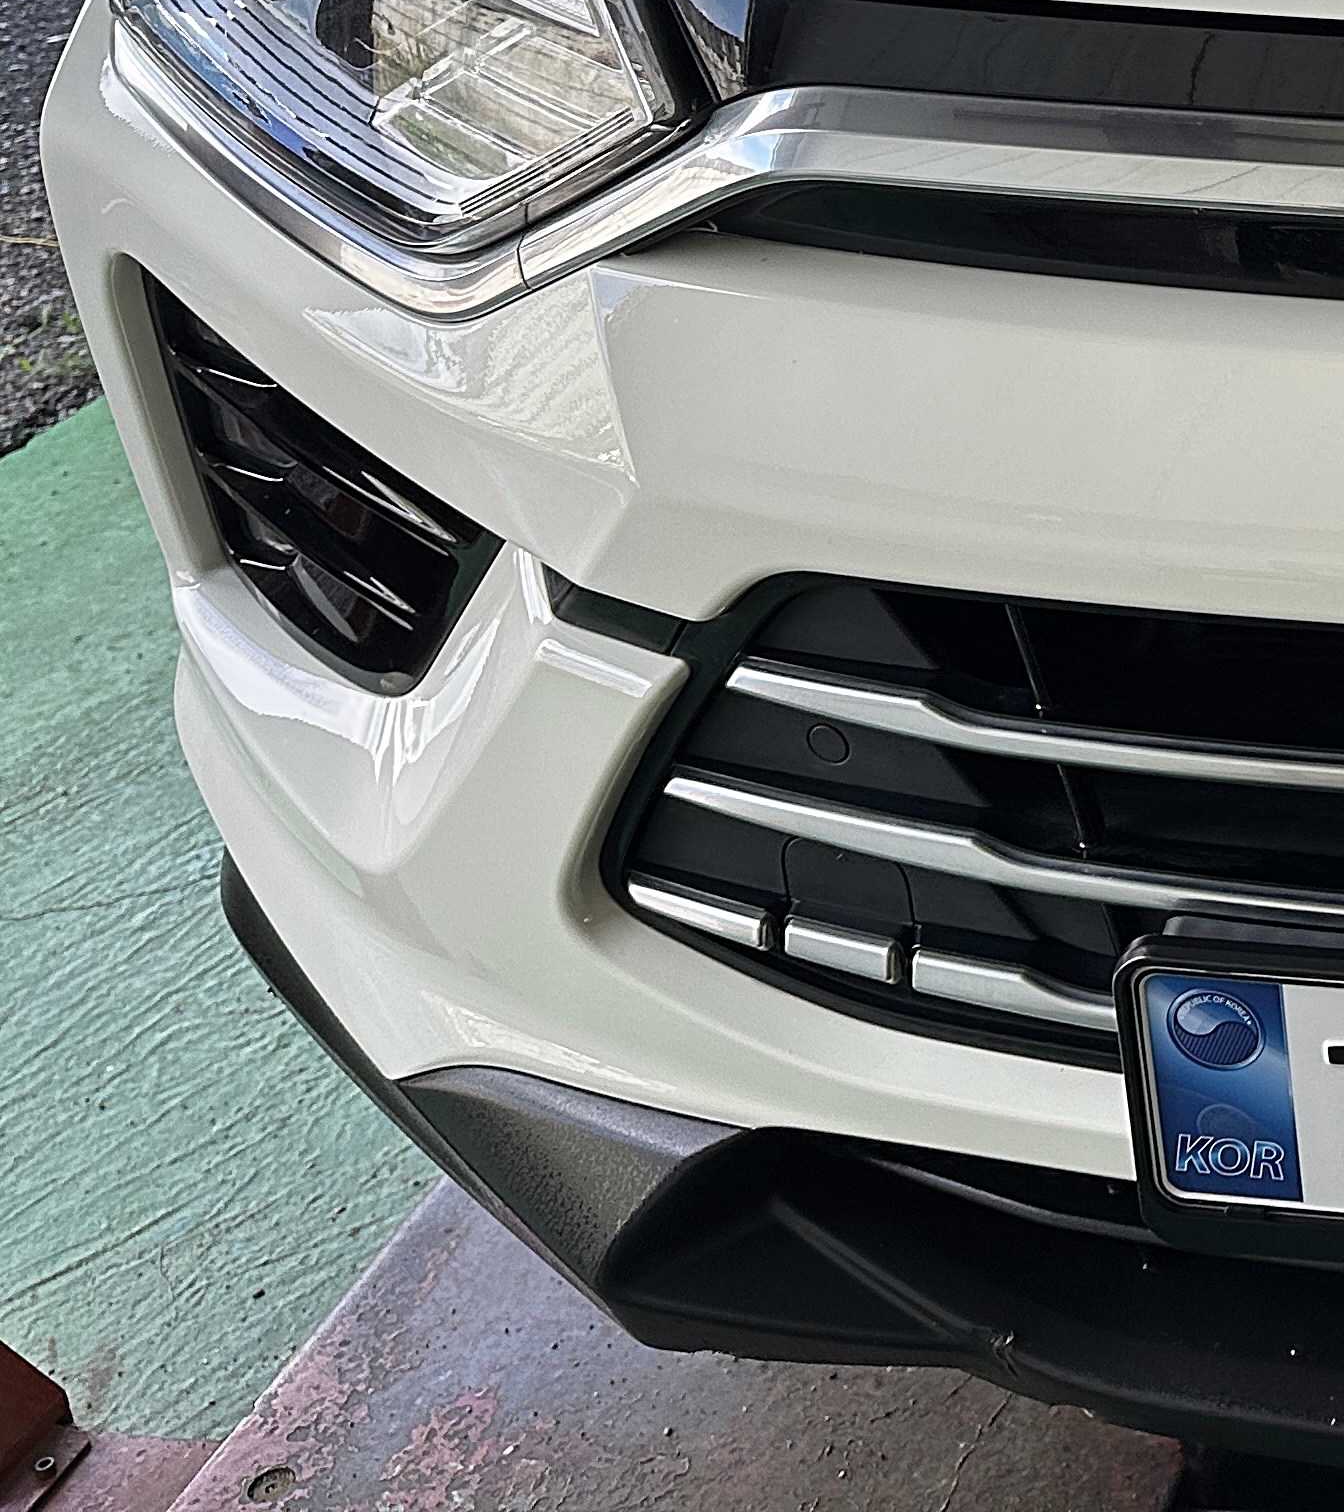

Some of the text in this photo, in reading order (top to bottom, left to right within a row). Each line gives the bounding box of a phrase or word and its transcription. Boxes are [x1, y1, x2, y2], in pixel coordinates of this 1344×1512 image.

[1212, 995, 1226, 1004] OF
[1225, 999, 1250, 1022] KOREA
[1175, 1133, 1285, 1181] KOR
